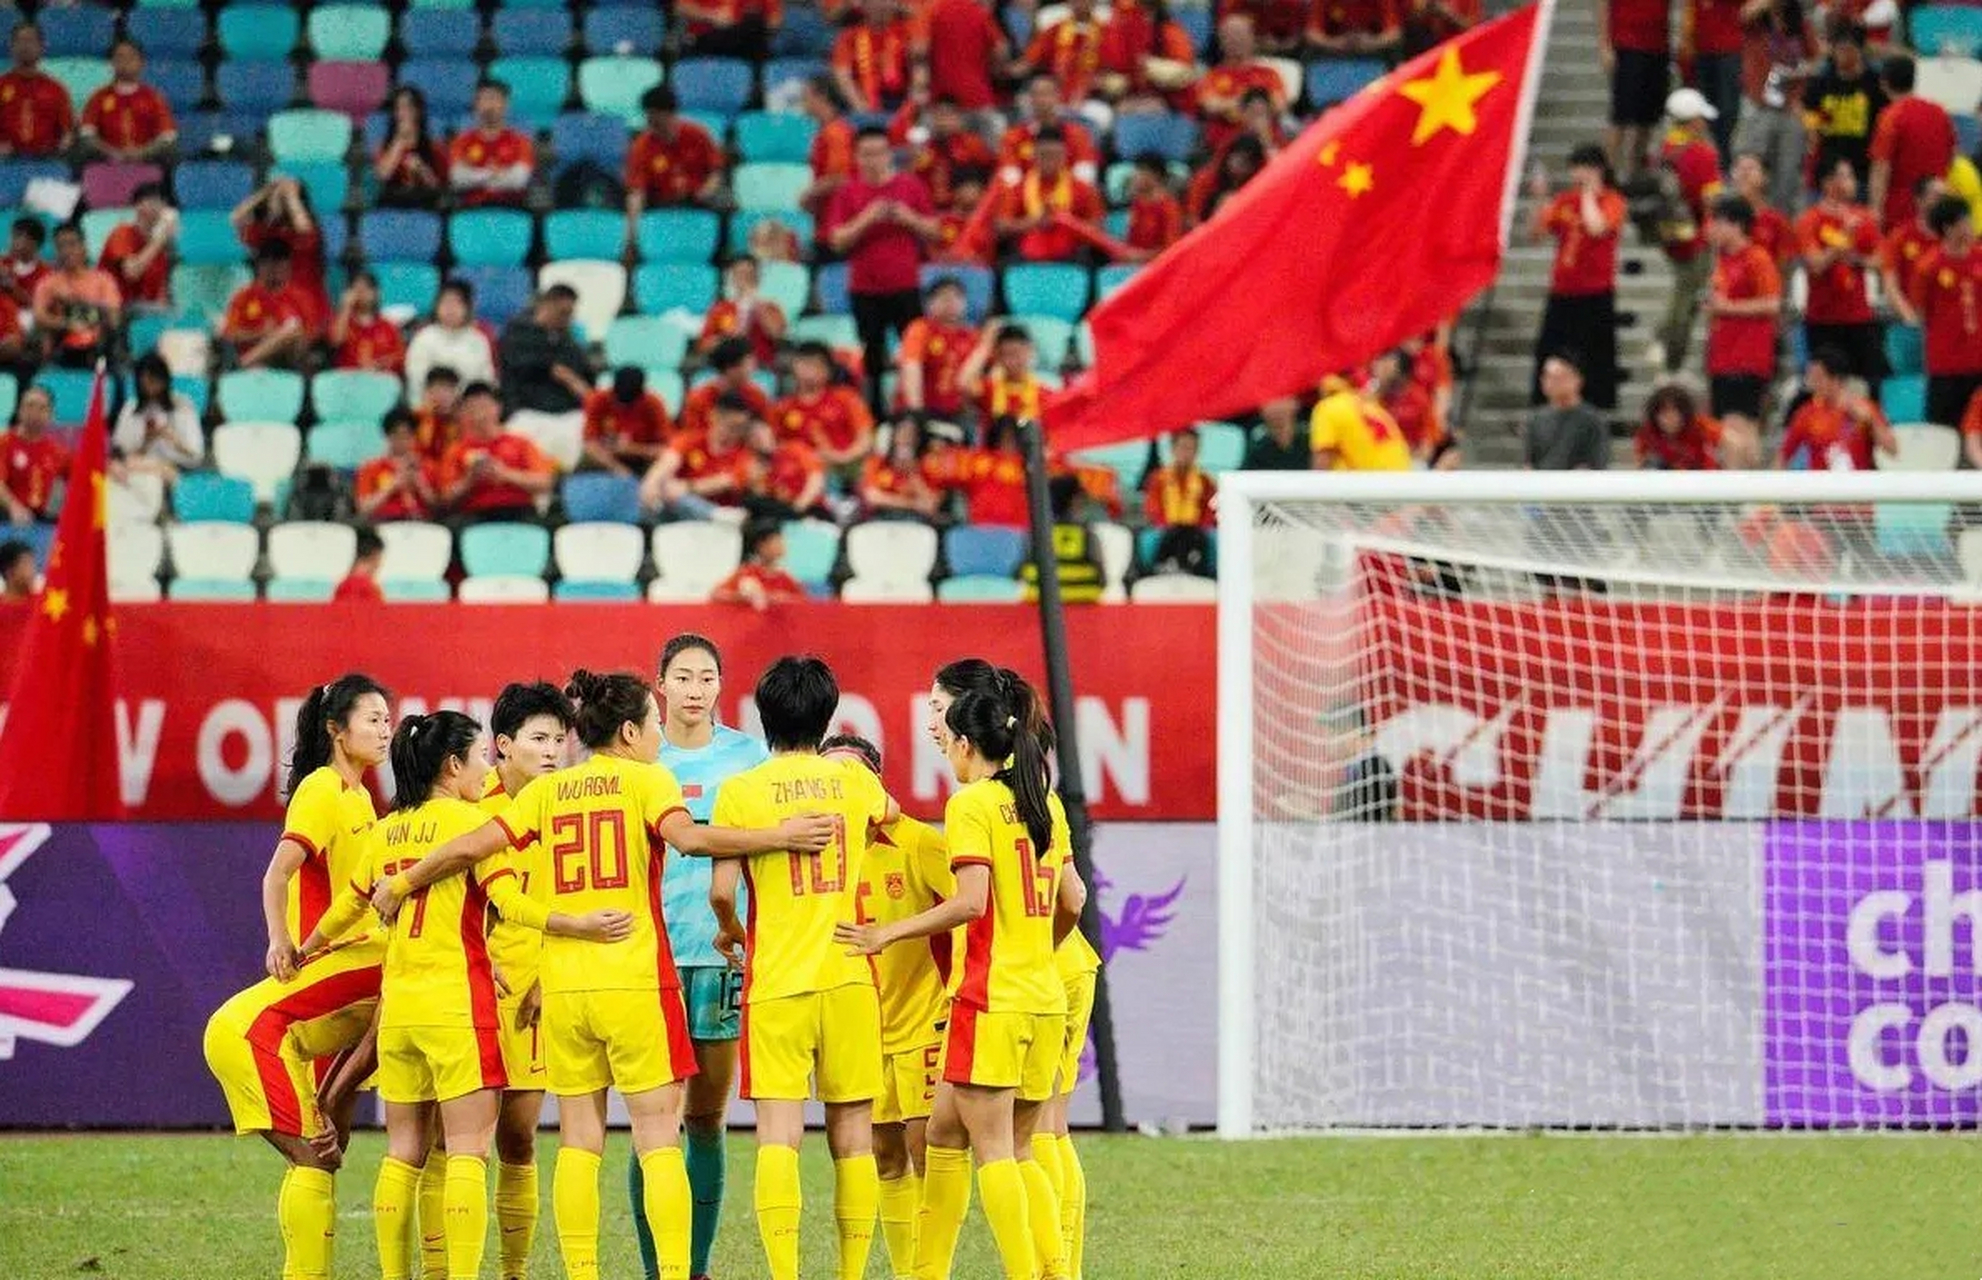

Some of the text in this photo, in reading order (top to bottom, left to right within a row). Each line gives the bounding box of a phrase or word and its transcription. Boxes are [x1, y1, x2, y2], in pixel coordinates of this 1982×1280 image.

[771, 778, 827, 804] ZHANG
[552, 809, 629, 895] 20
[1014, 837, 1055, 917] 15
